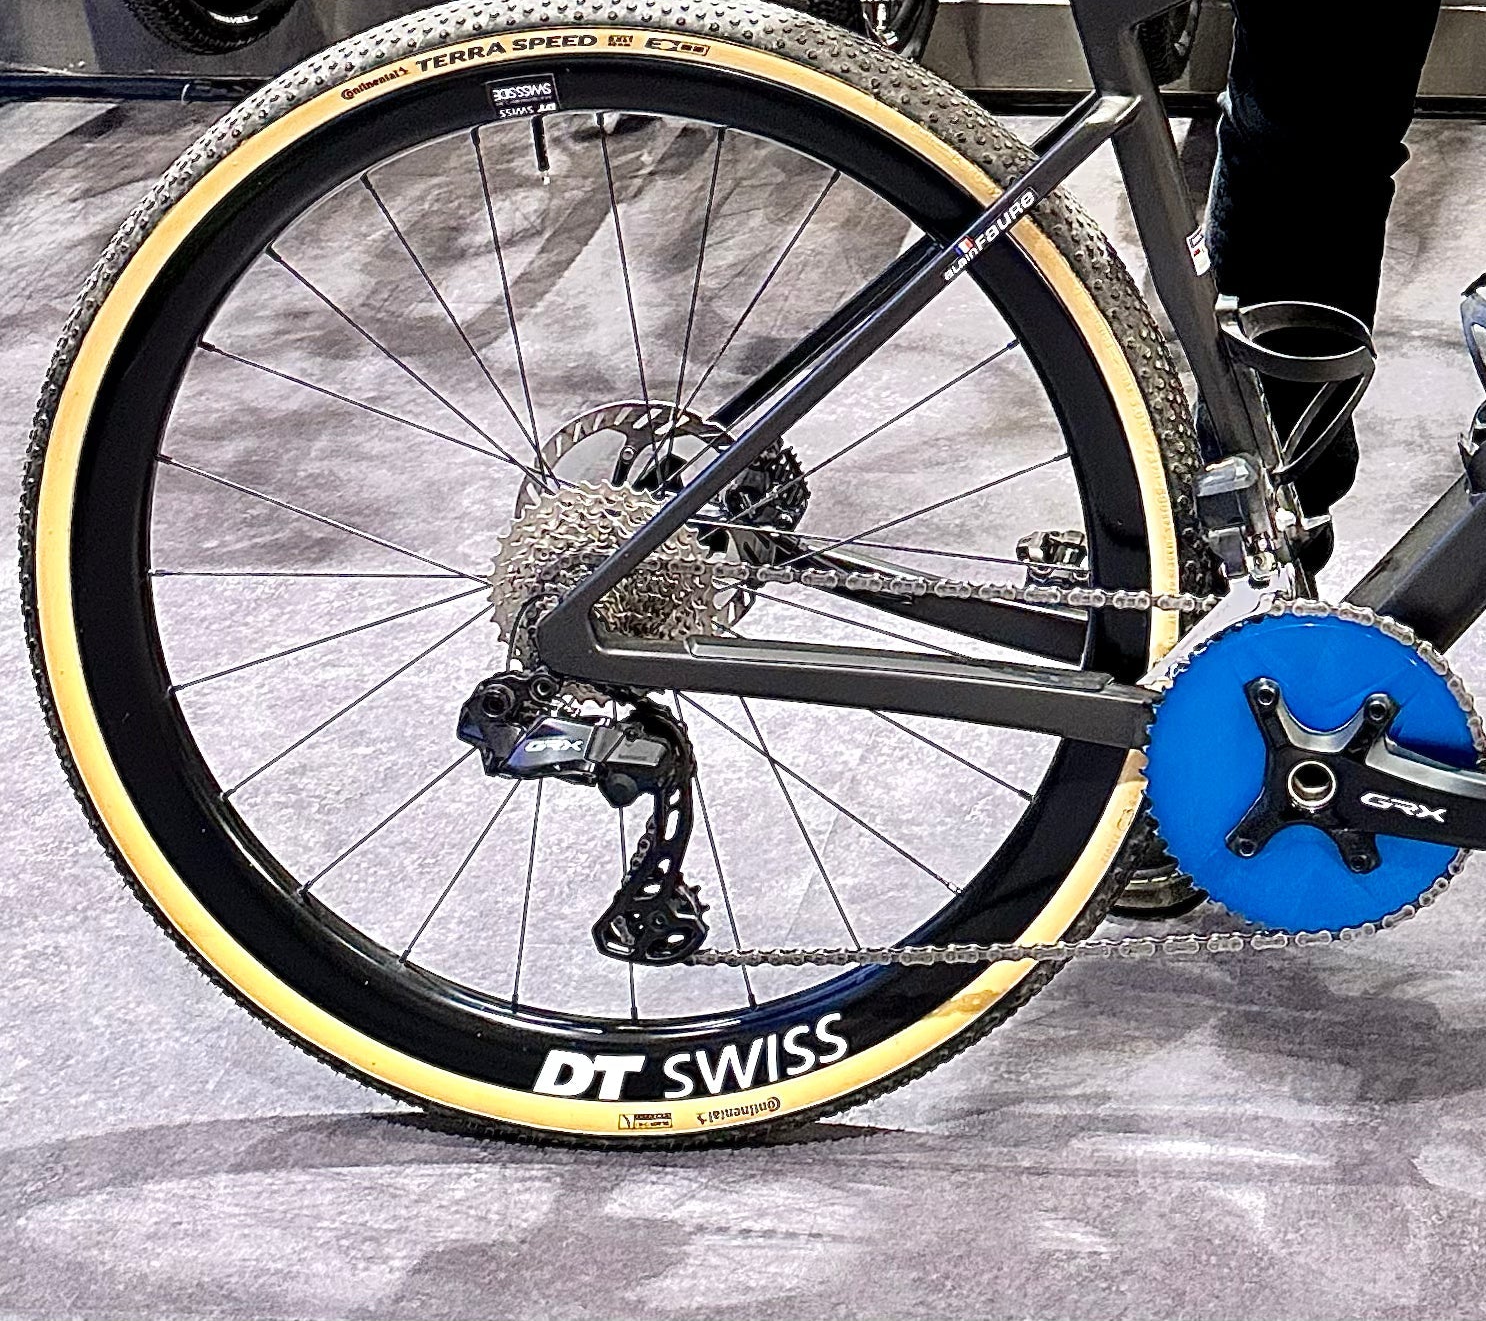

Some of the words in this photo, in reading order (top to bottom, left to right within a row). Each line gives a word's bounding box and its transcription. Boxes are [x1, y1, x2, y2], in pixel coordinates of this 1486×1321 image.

[340, 69, 399, 101] Continental
[415, 41, 507, 73] TERRA
[511, 34, 598, 52] SPEED
[499, 105, 535, 118] SWISS
[525, 739, 584, 753] GRX
[1359, 792, 1447, 824] GRX
[532, 1049, 646, 1101] DT
[663, 1012, 849, 1100] SWISS
